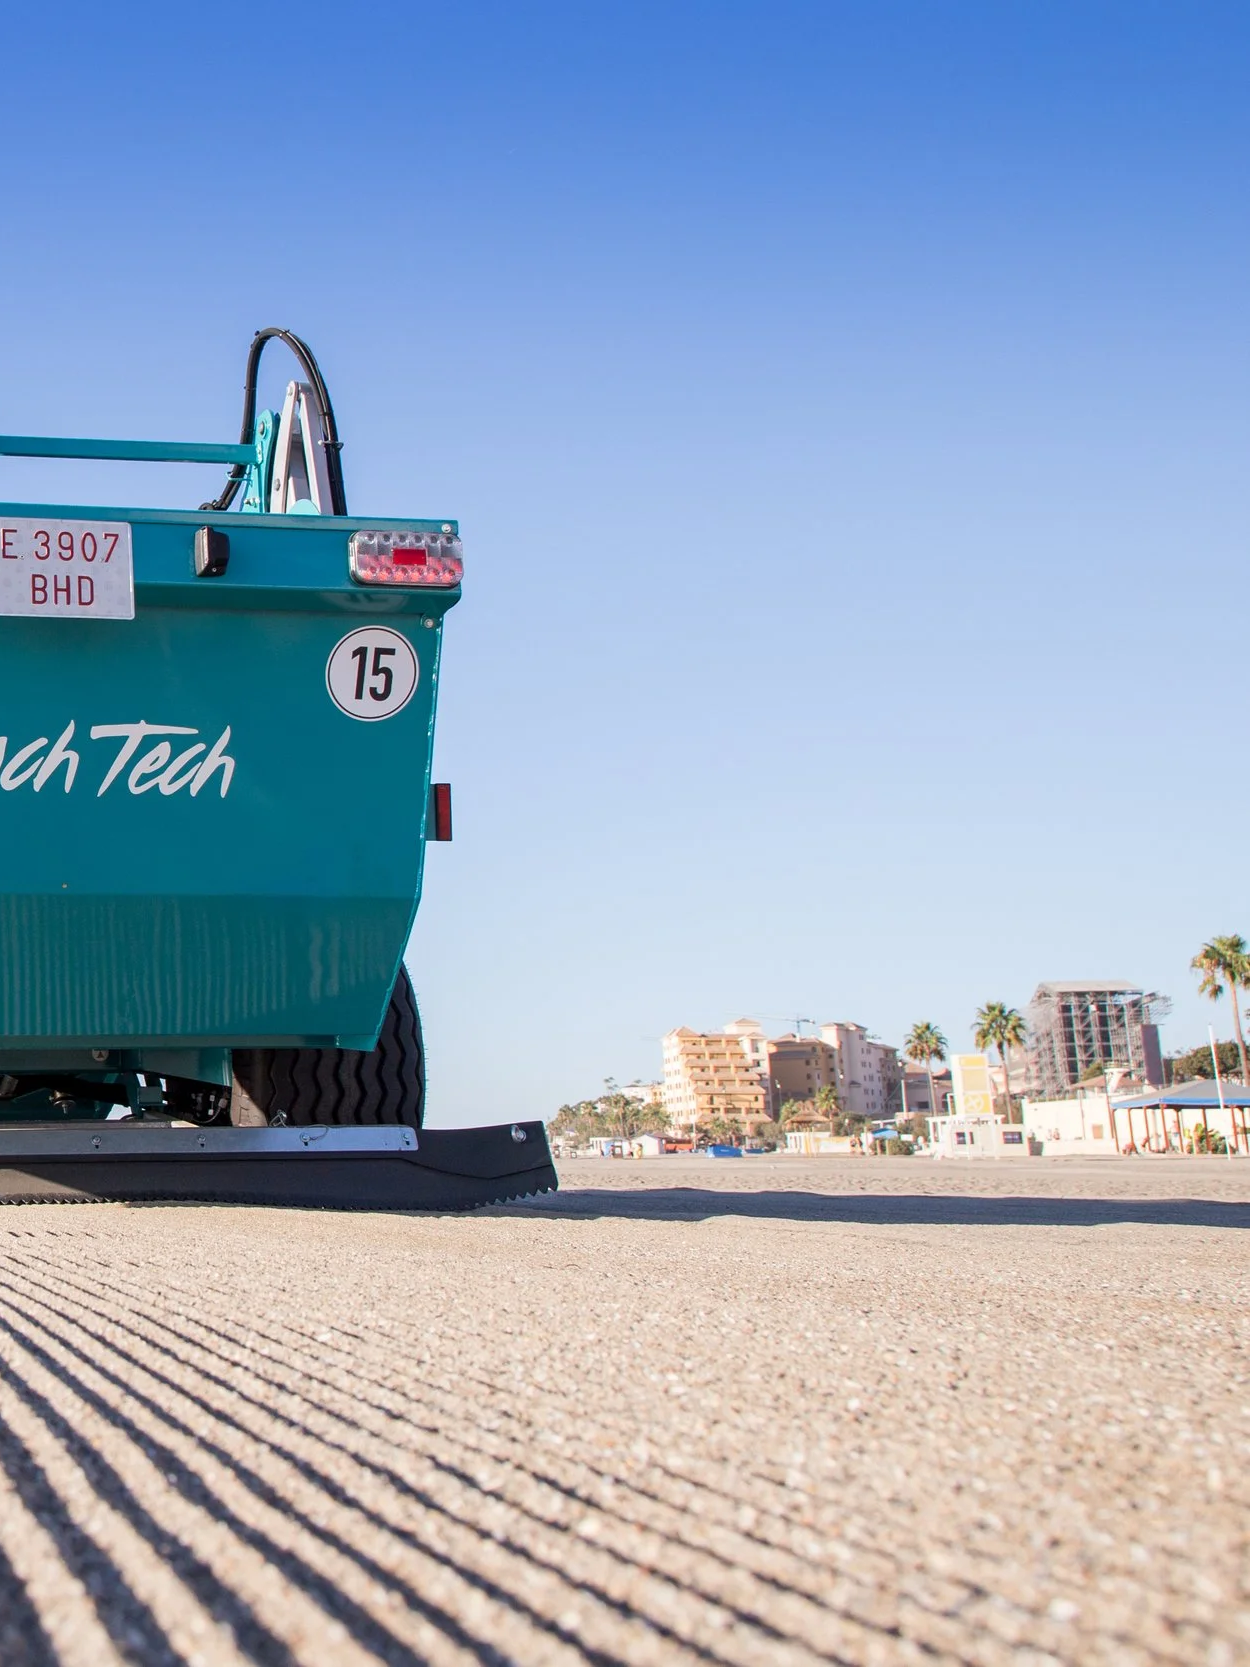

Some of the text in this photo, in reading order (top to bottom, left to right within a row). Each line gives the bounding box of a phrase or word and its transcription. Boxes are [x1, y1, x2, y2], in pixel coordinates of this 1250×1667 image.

[1, 528, 120, 563] E 3907
[31, 573, 95, 606] BHD
[351, 646, 396, 702] 15
[90, 719, 236, 799] Tech
